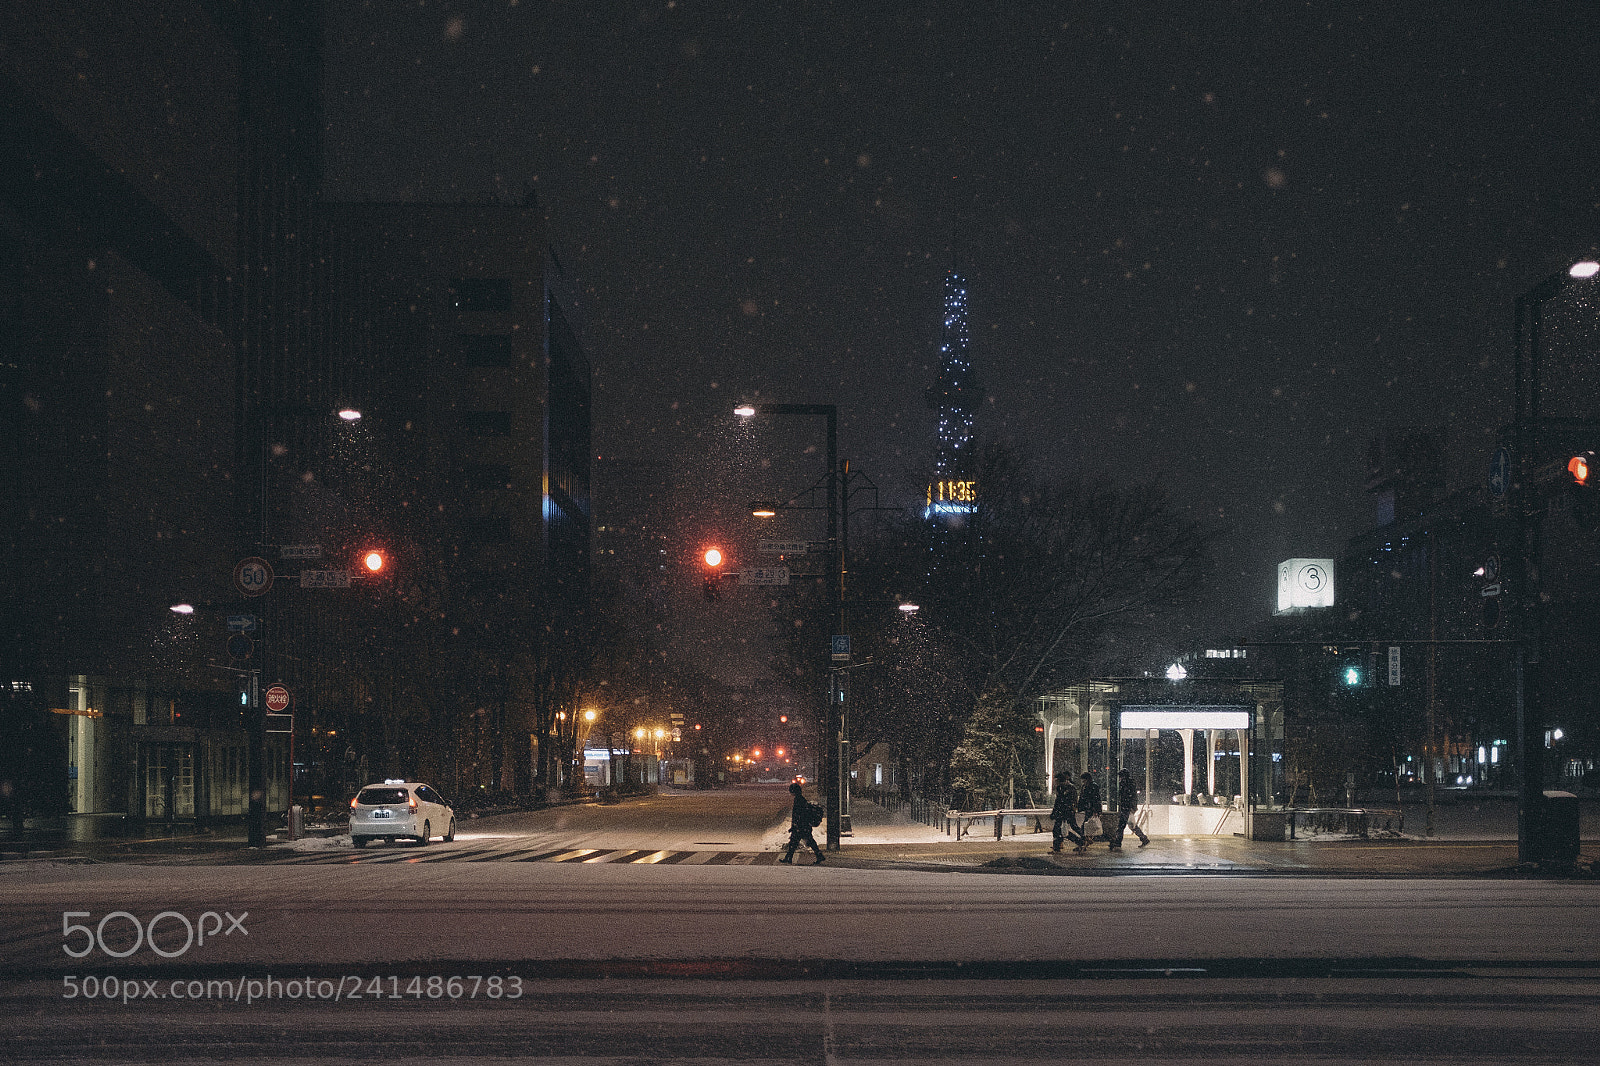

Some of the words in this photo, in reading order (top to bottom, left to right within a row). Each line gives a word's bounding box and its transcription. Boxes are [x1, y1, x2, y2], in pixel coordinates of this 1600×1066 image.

[937, 481, 977, 502] 11:35
[242, 567, 265, 586] 50
[1305, 567, 1321, 590] 3
[267, 694, 287, 704] 消火栓
